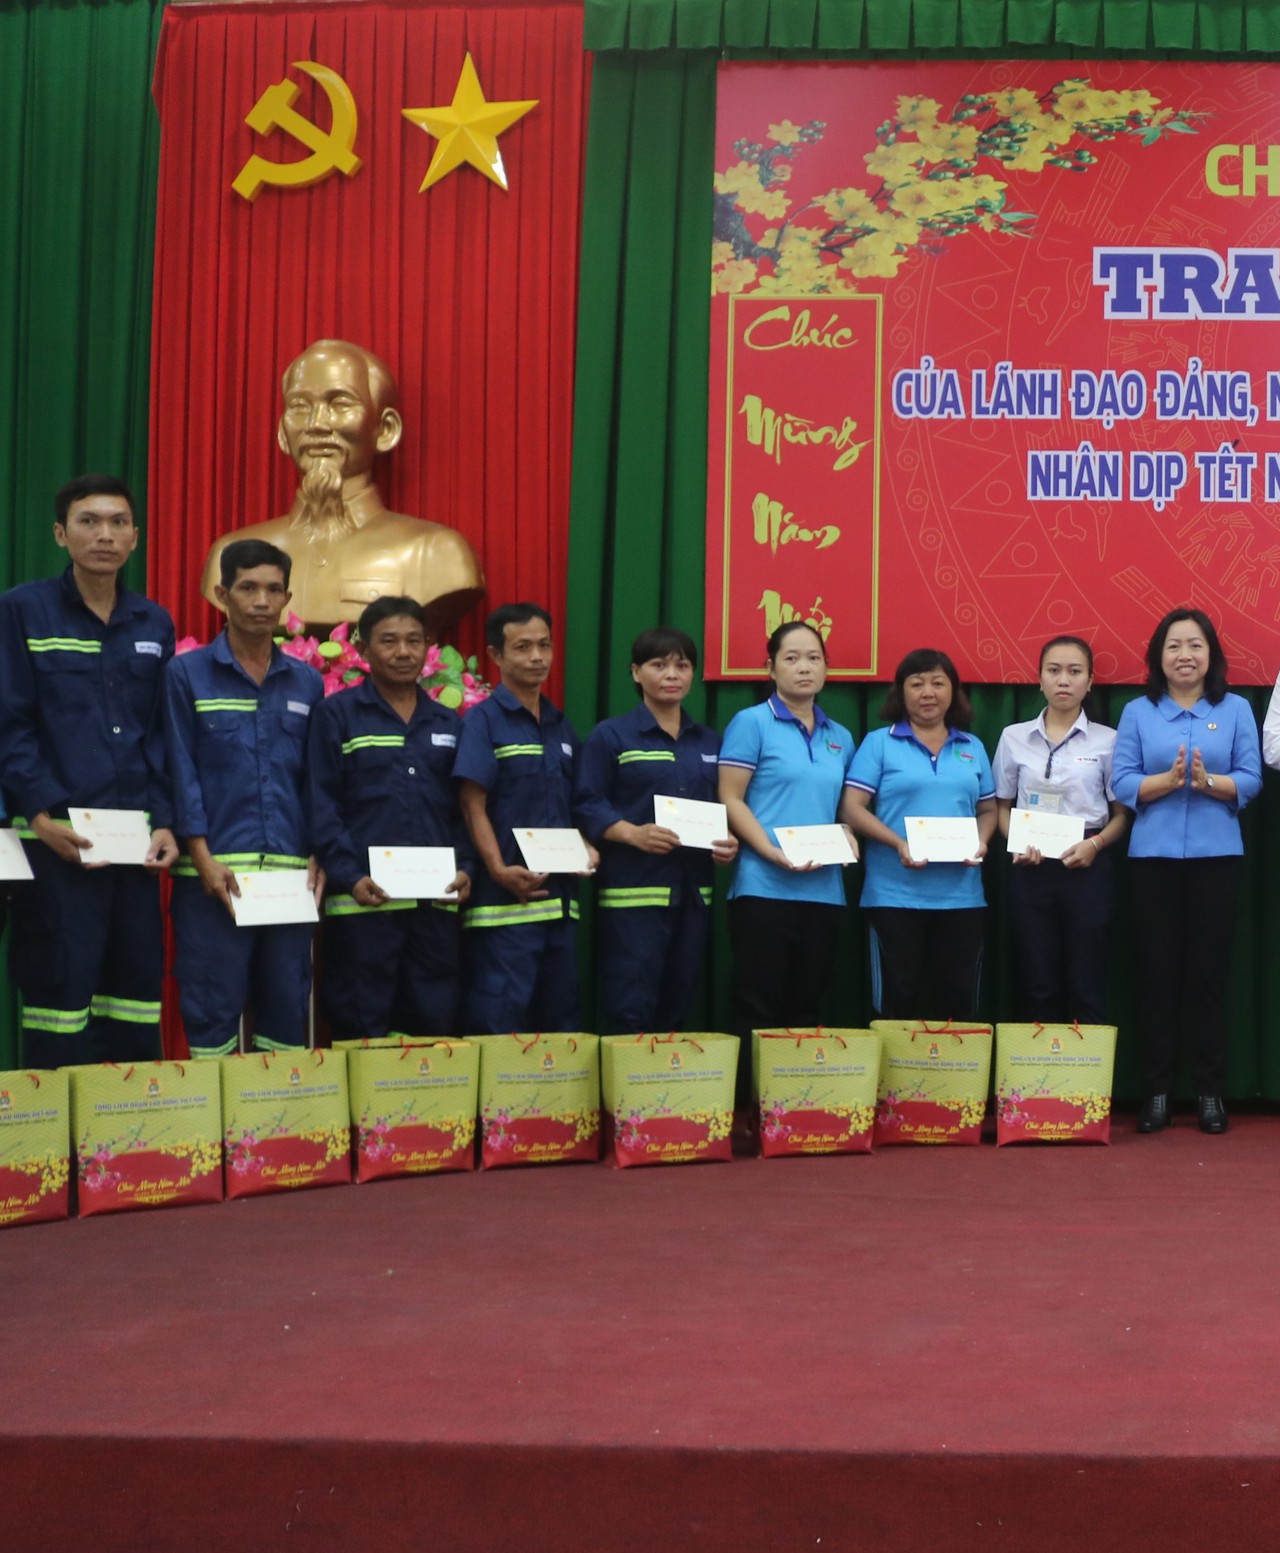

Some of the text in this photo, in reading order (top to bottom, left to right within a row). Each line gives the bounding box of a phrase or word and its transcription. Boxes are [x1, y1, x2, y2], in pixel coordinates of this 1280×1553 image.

[744, 305, 858, 350] Chúc
[894, 356, 965, 420] CỦA
[972, 362, 1061, 419] LÃNH
[1069, 370, 1146, 429] ĐẠO
[1154, 357, 1258, 425] ĐẢNG,
[738, 395, 872, 471] Mừng
[1027, 441, 1122, 500] NHÂN
[1130, 451, 1186, 511] DỊP
[1195, 439, 1256, 502] TẾT
[751, 492, 840, 559] Năm
